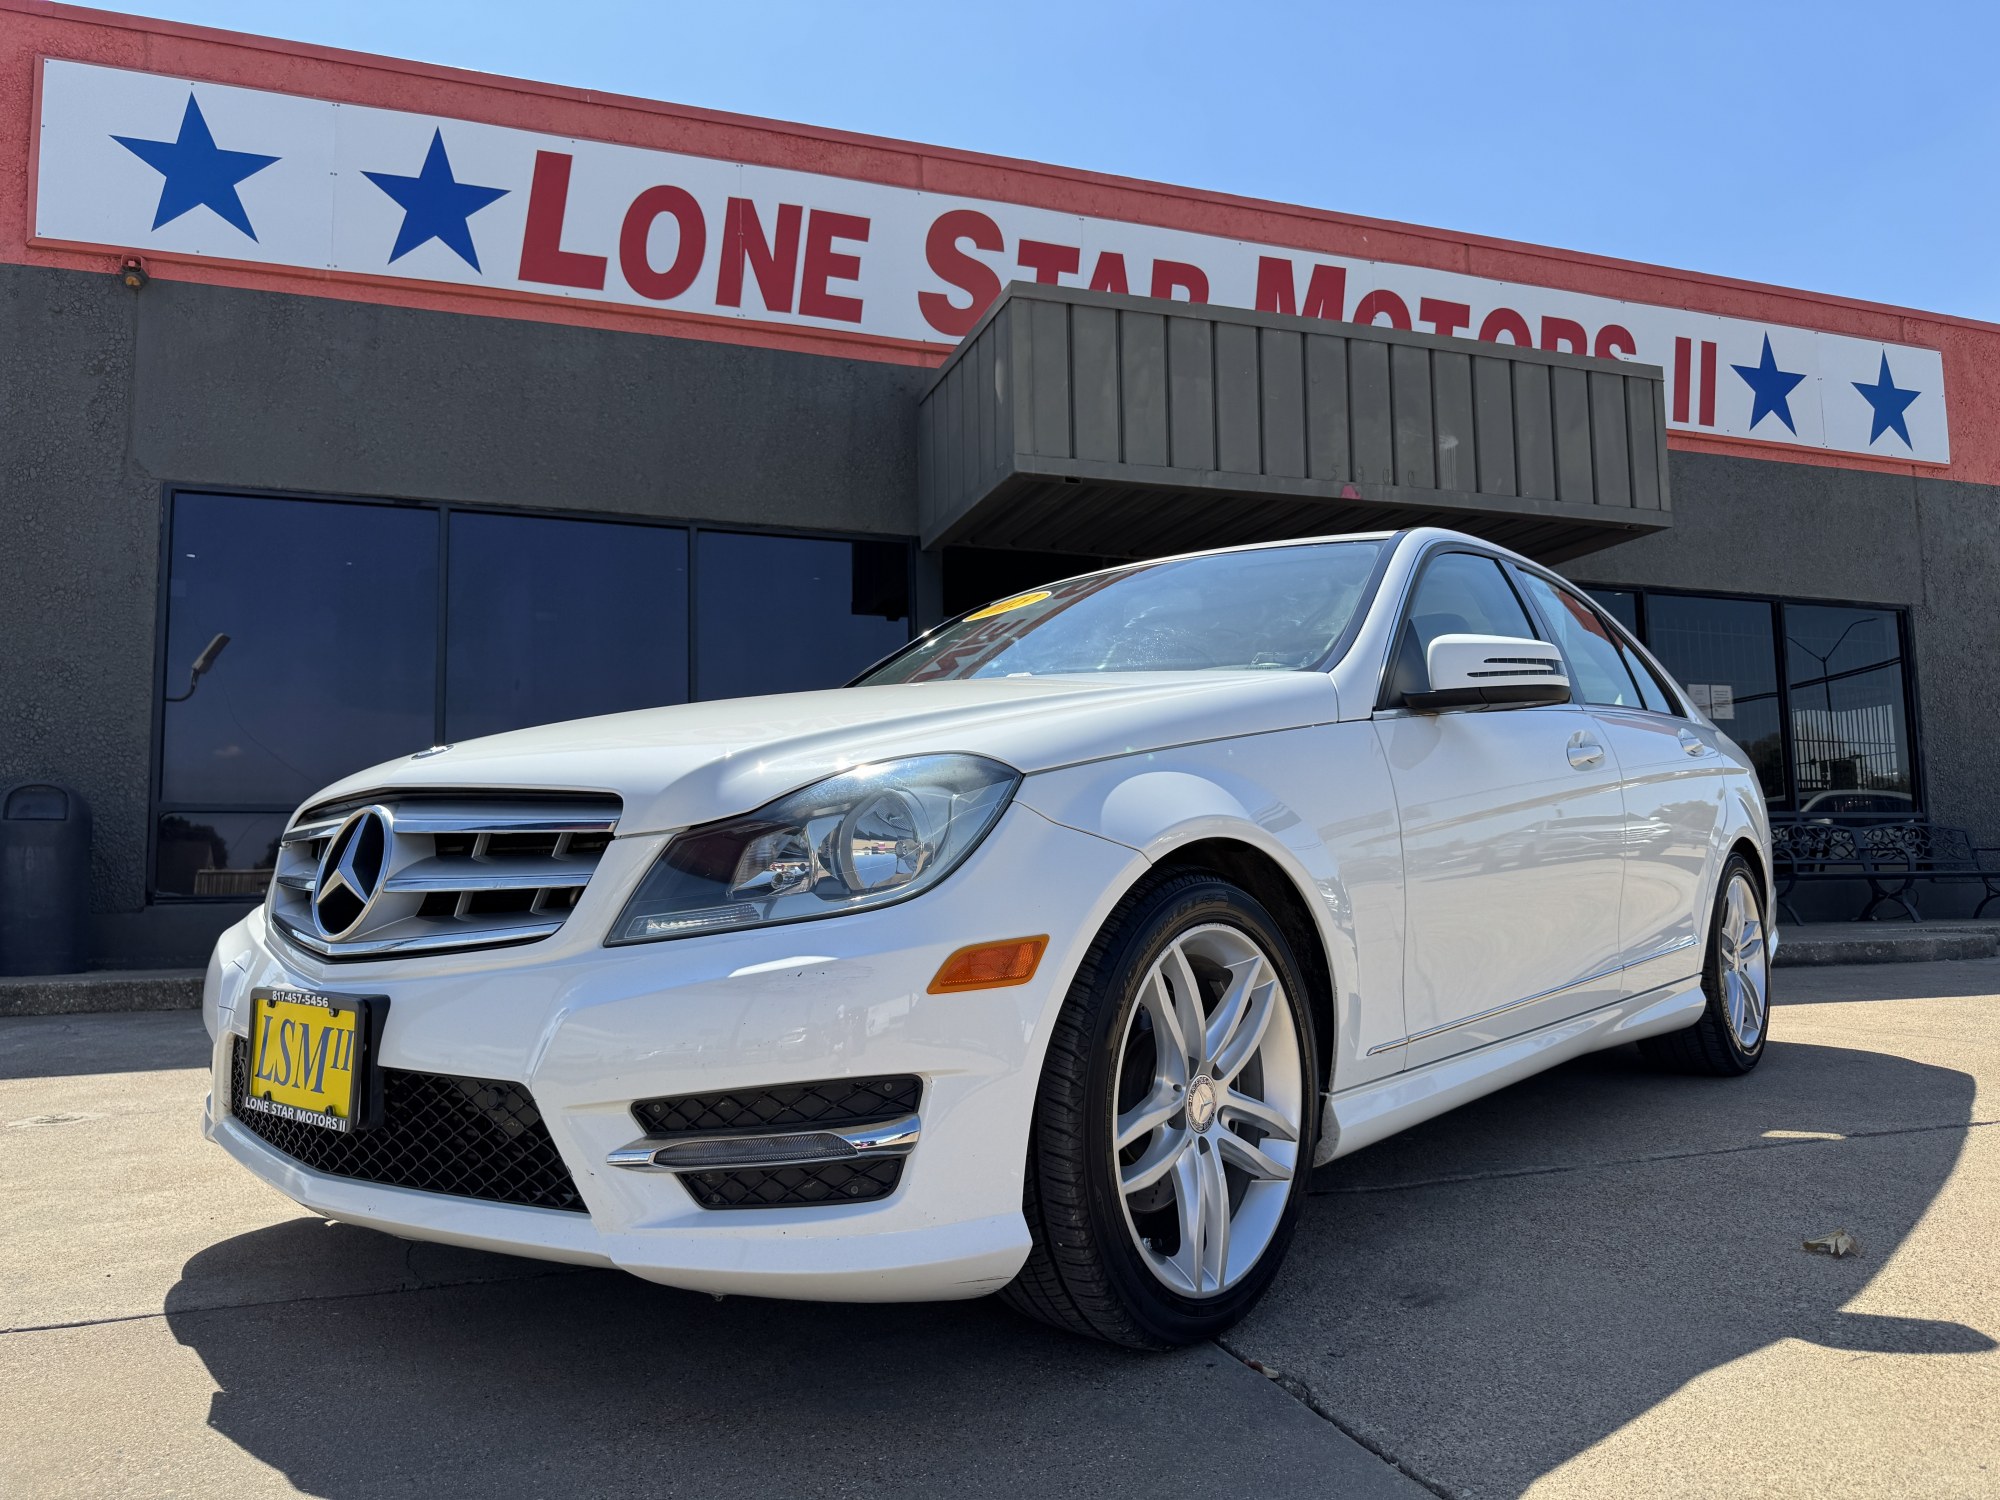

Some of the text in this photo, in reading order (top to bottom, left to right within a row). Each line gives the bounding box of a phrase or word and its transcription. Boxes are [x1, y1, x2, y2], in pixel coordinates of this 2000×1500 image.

[518, 149, 871, 324] LONE
[1673, 336, 1717, 427] II
[272, 990, 329, 1008] 817-457-5456
[245, 1096, 346, 1132] LONE STAR MOTORS II
